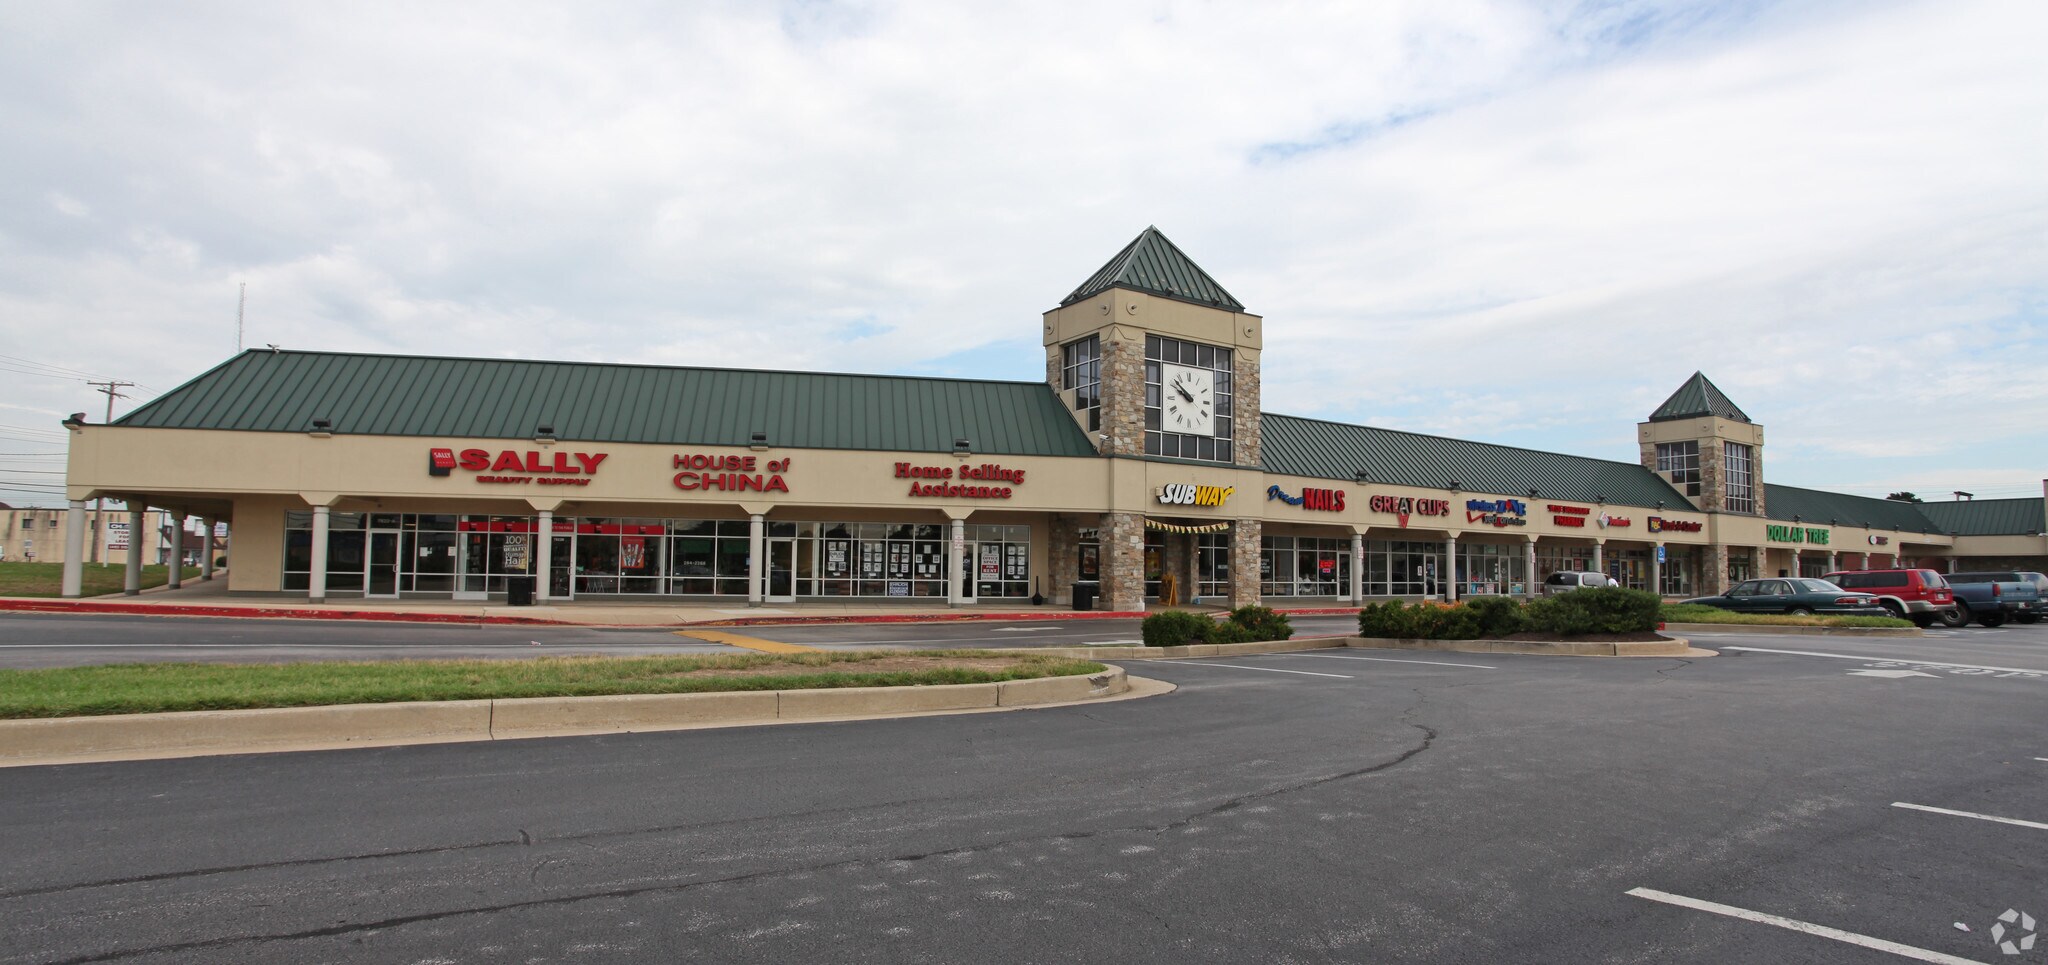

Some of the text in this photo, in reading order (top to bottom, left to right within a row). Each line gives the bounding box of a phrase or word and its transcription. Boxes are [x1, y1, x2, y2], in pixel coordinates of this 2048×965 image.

[459, 448, 608, 474] SALLY
[673, 454, 790, 472] HOUSE of
[476, 475, 591, 486] BEAUTY SUPPLY
[673, 471, 789, 493] CHINA
[894, 462, 1025, 485] Home Selling
[908, 481, 1012, 498] Assistance
[1160, 483, 1235, 506] SUBWAY
[1302, 487, 1346, 511] NAILS
[1370, 495, 1450, 517] GREAT CLIPS
[1766, 524, 1829, 545] DOLLAR TREE
[504, 556, 525, 565] Hair
